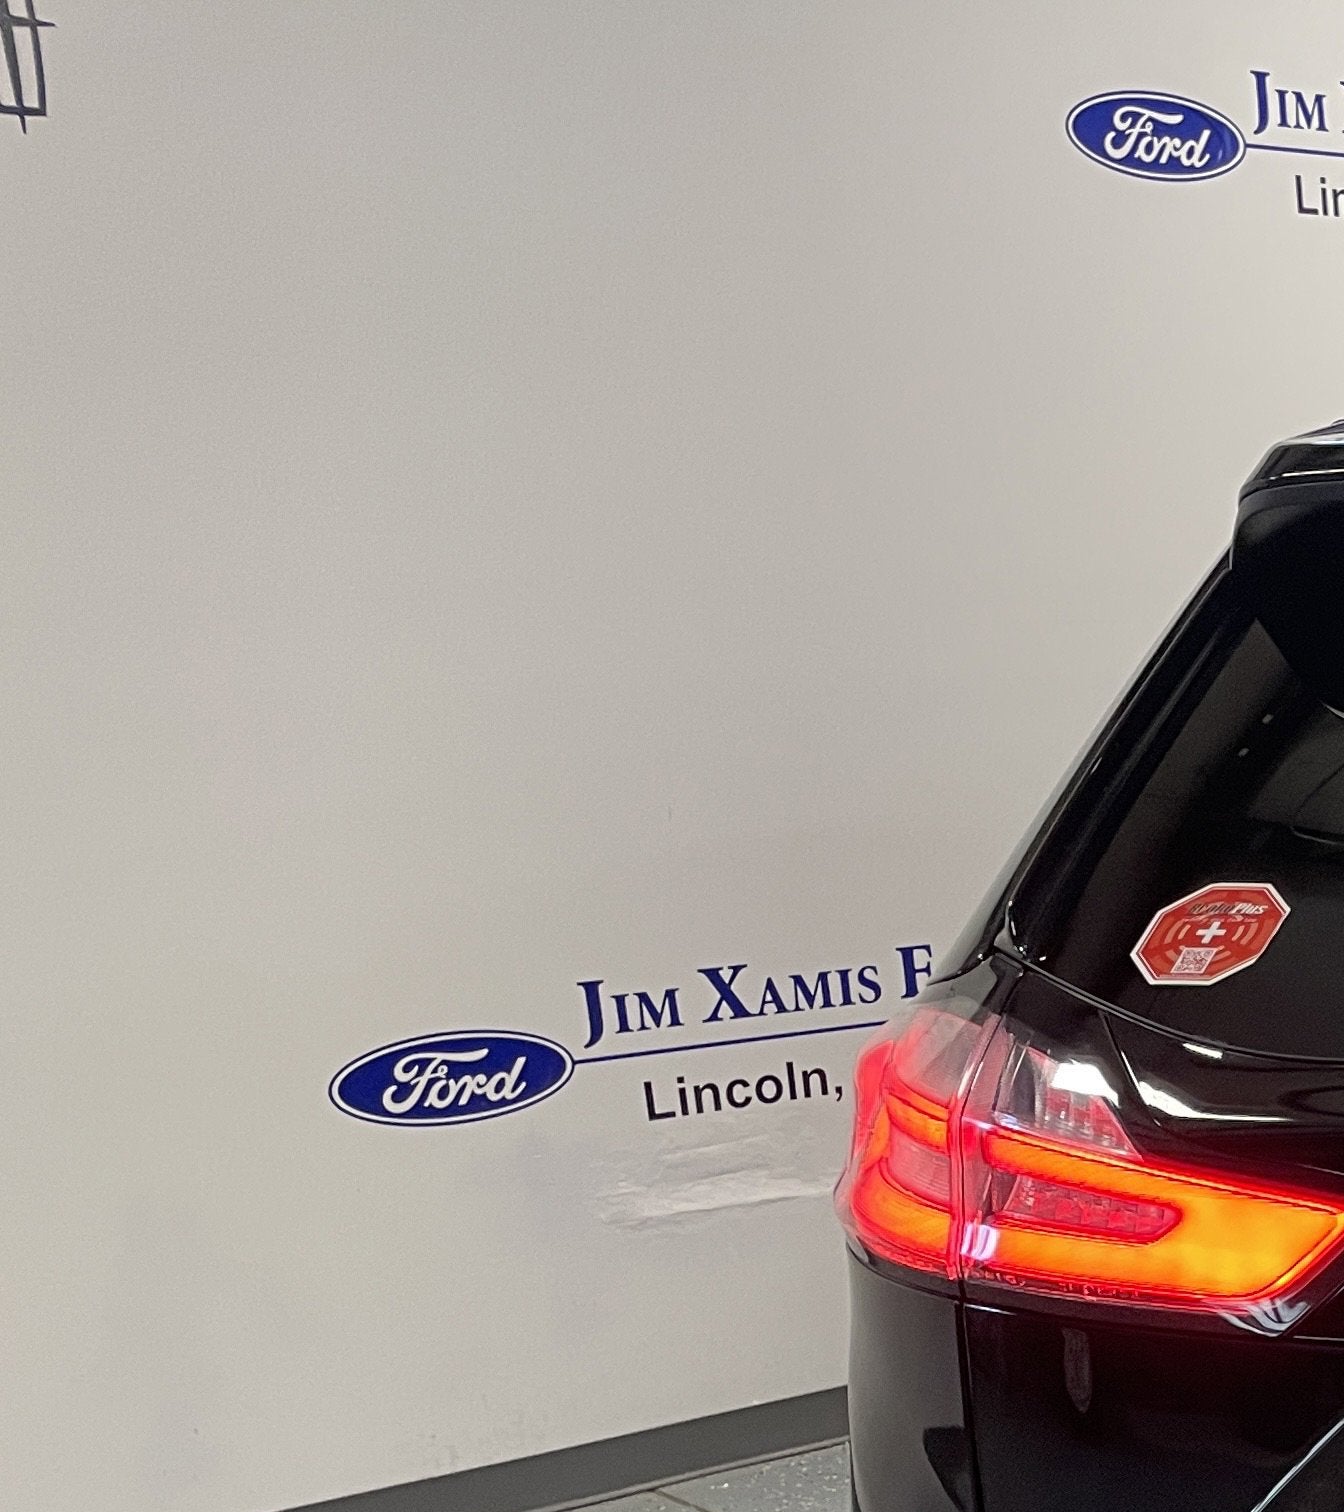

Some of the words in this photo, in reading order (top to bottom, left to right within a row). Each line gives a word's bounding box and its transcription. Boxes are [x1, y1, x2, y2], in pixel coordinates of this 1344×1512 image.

[1249, 69, 1329, 136] JIM
[1104, 106, 1210, 169] Ford
[576, 979, 685, 1050] JIM
[696, 963, 883, 1025] XAMIS
[382, 1048, 527, 1114] Ford
[643, 1061, 843, 1122] Lincoln,
